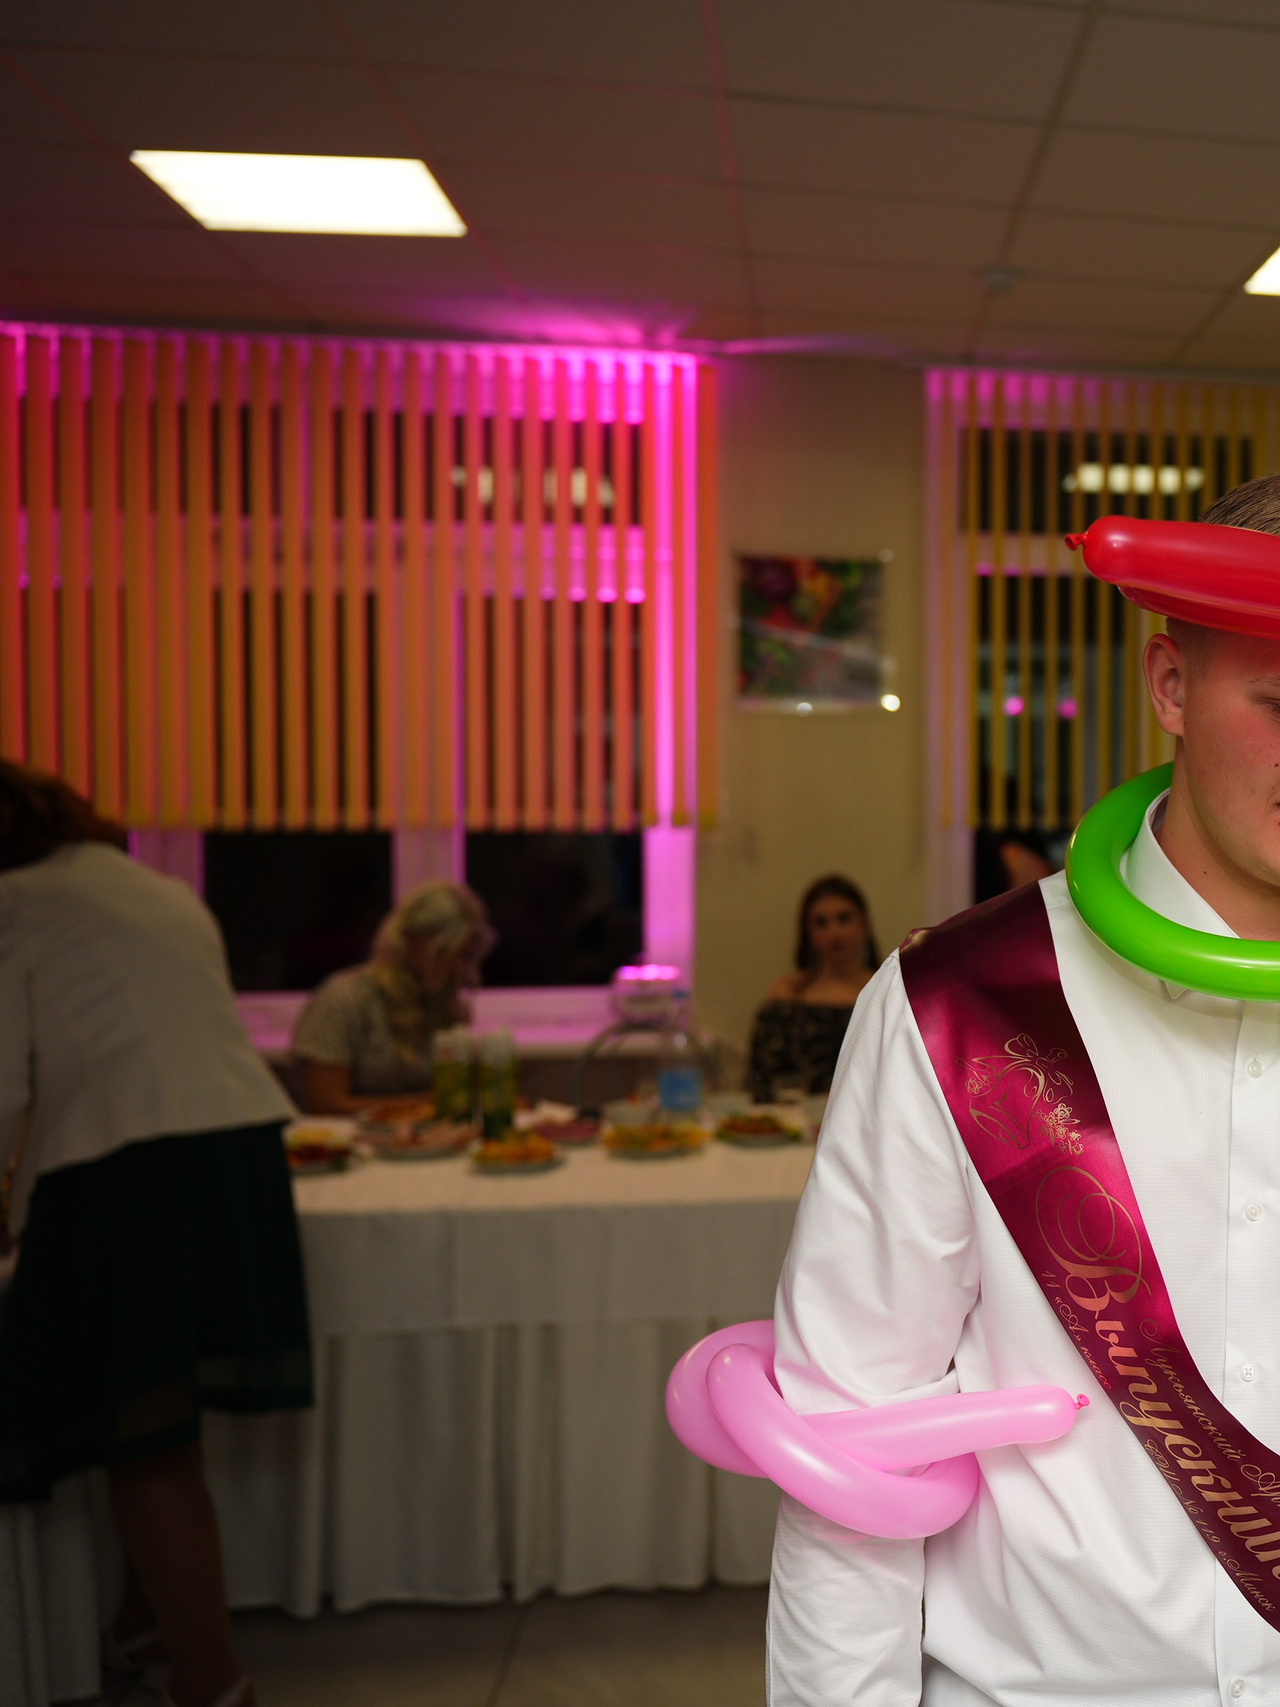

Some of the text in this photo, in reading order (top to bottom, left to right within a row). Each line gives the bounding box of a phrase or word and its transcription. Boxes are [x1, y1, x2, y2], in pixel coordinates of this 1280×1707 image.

[1041, 1270, 1062, 1288] 11
[1080, 1346, 1112, 1389] класс
[1140, 1319, 1245, 1462] Лукьянский
[1171, 1483, 1203, 1515] №
[1195, 1518, 1222, 1544] 119
